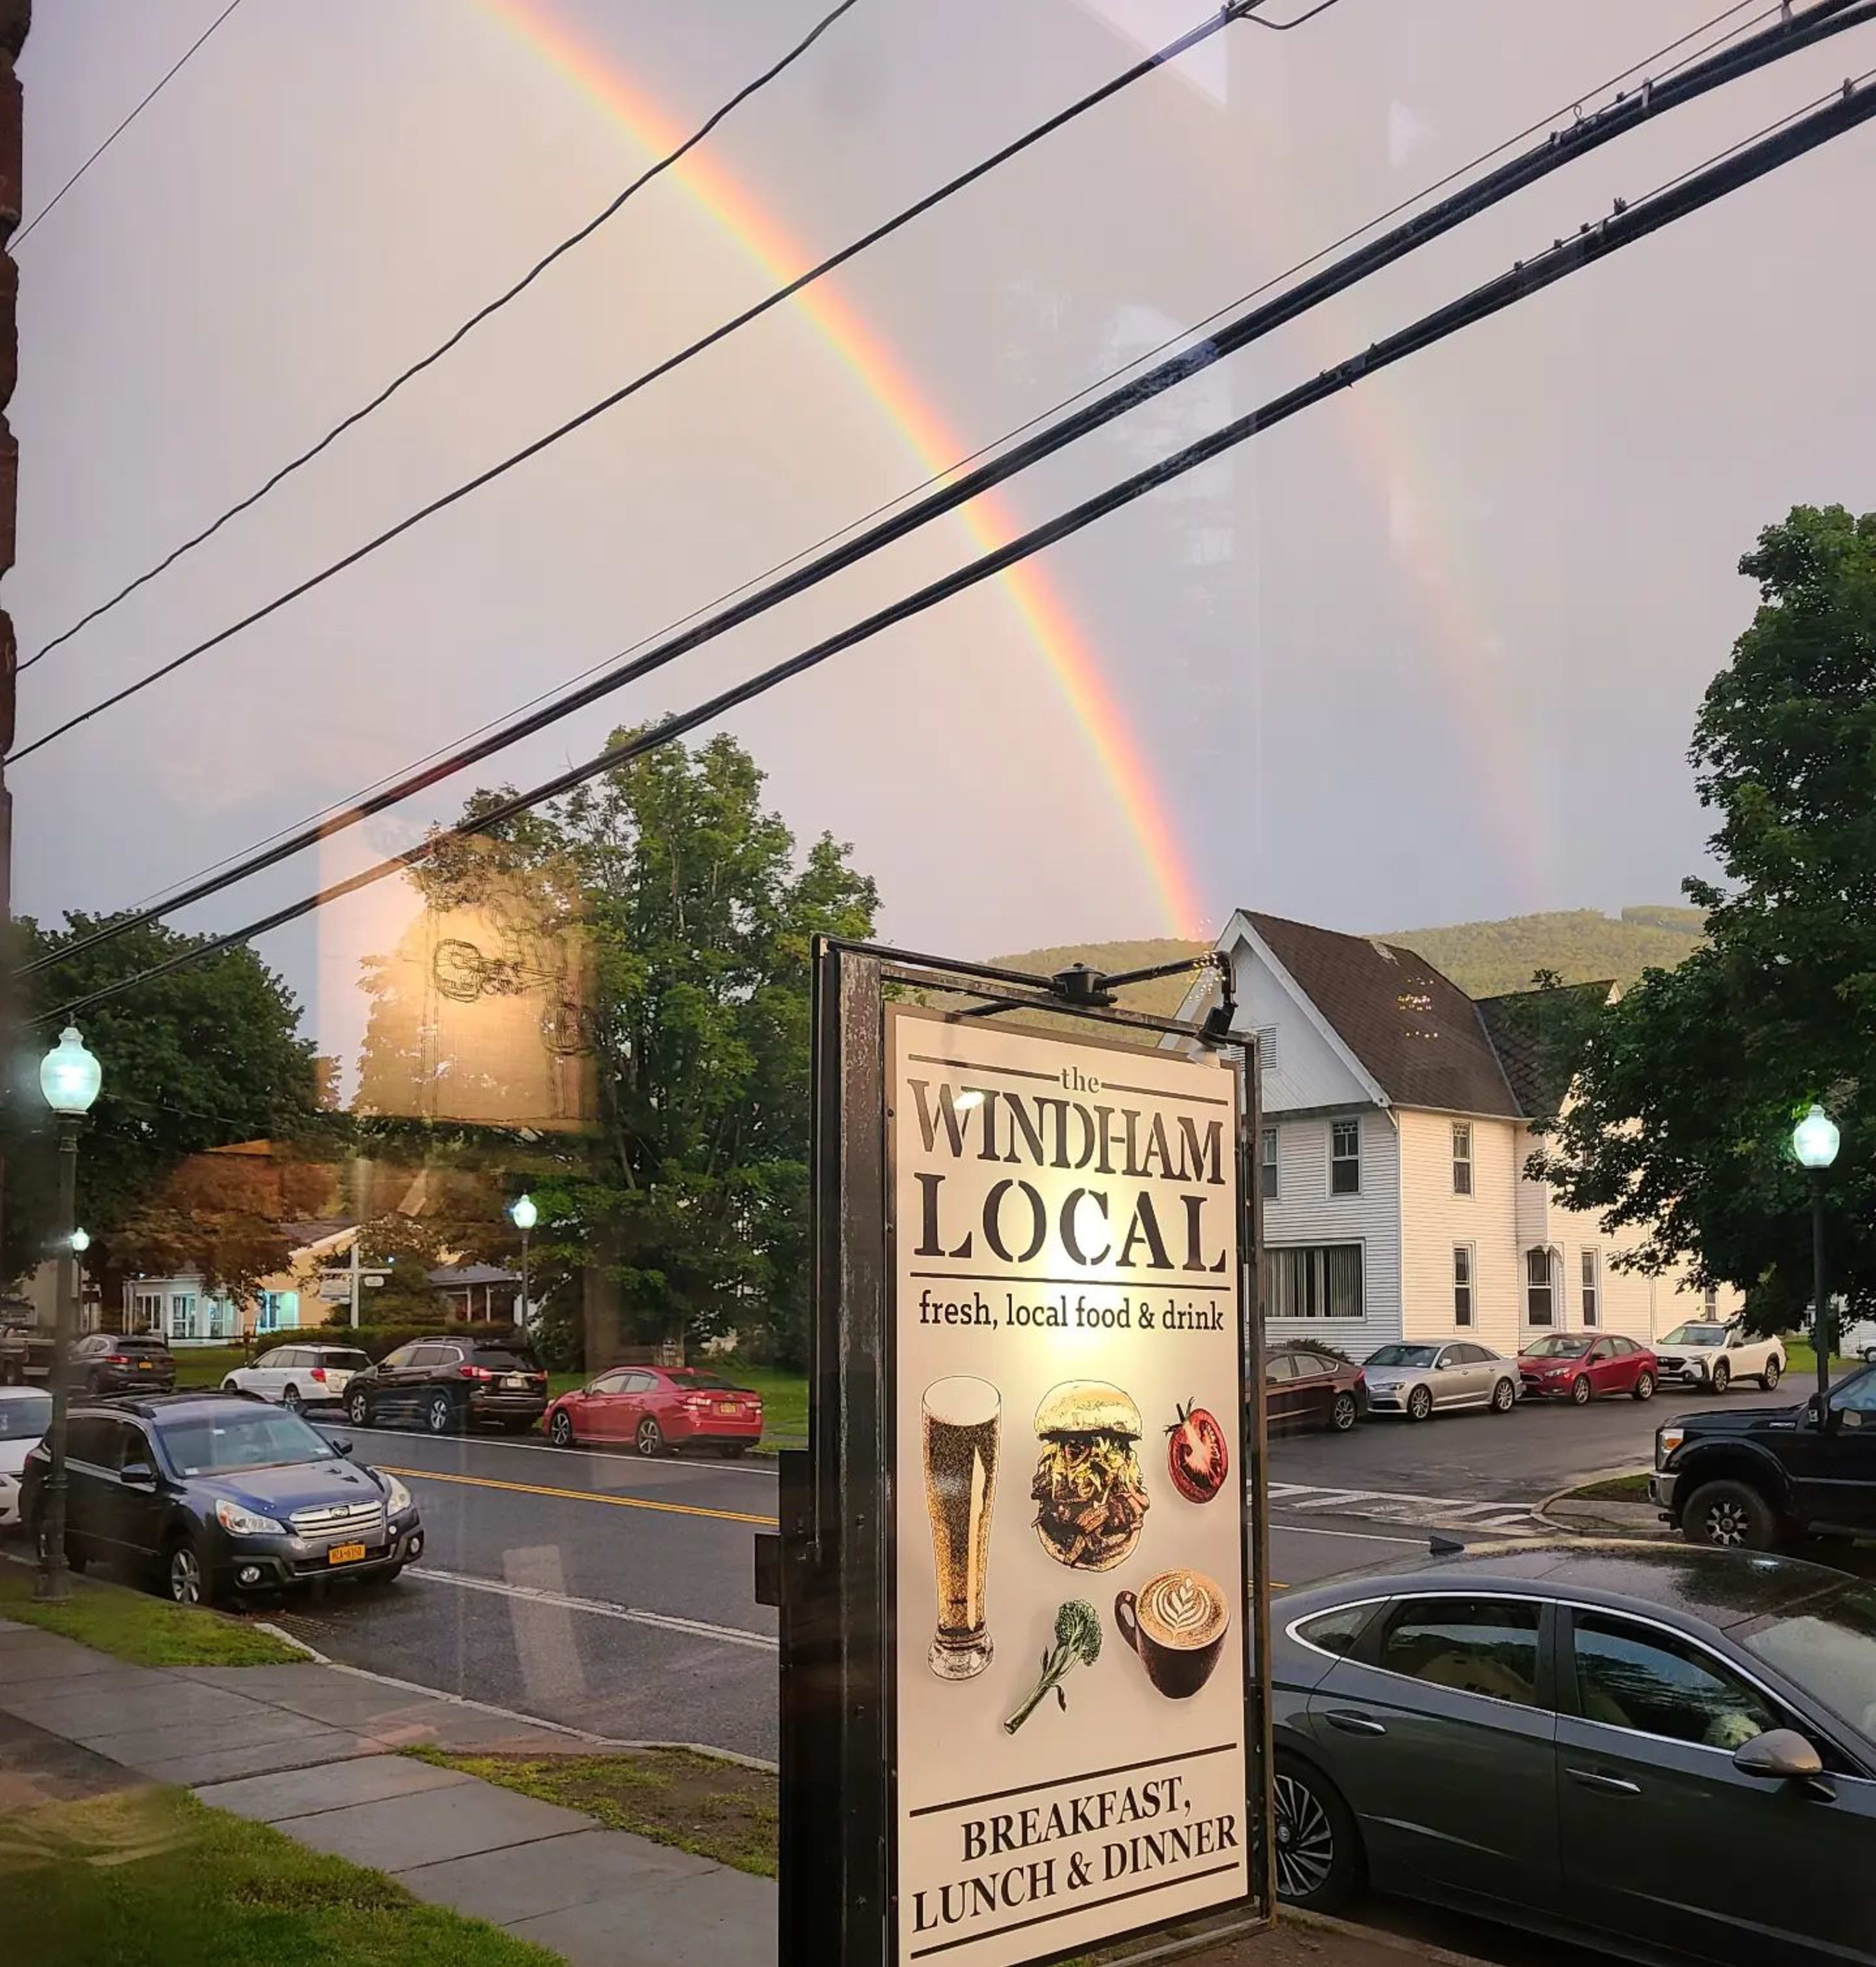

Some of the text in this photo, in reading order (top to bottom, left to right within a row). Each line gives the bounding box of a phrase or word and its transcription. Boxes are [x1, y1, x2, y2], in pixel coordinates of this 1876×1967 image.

[1061, 1067, 1100, 1093] the
[908, 1079, 1226, 1184] WINDHAM
[914, 1173, 1226, 1272] LOCAL
[919, 1290, 1224, 1331] fresh, local food & drink
[961, 1777, 1191, 1862] BREAKFAST,
[913, 1814, 1239, 1933] LUNCH & DINNER
